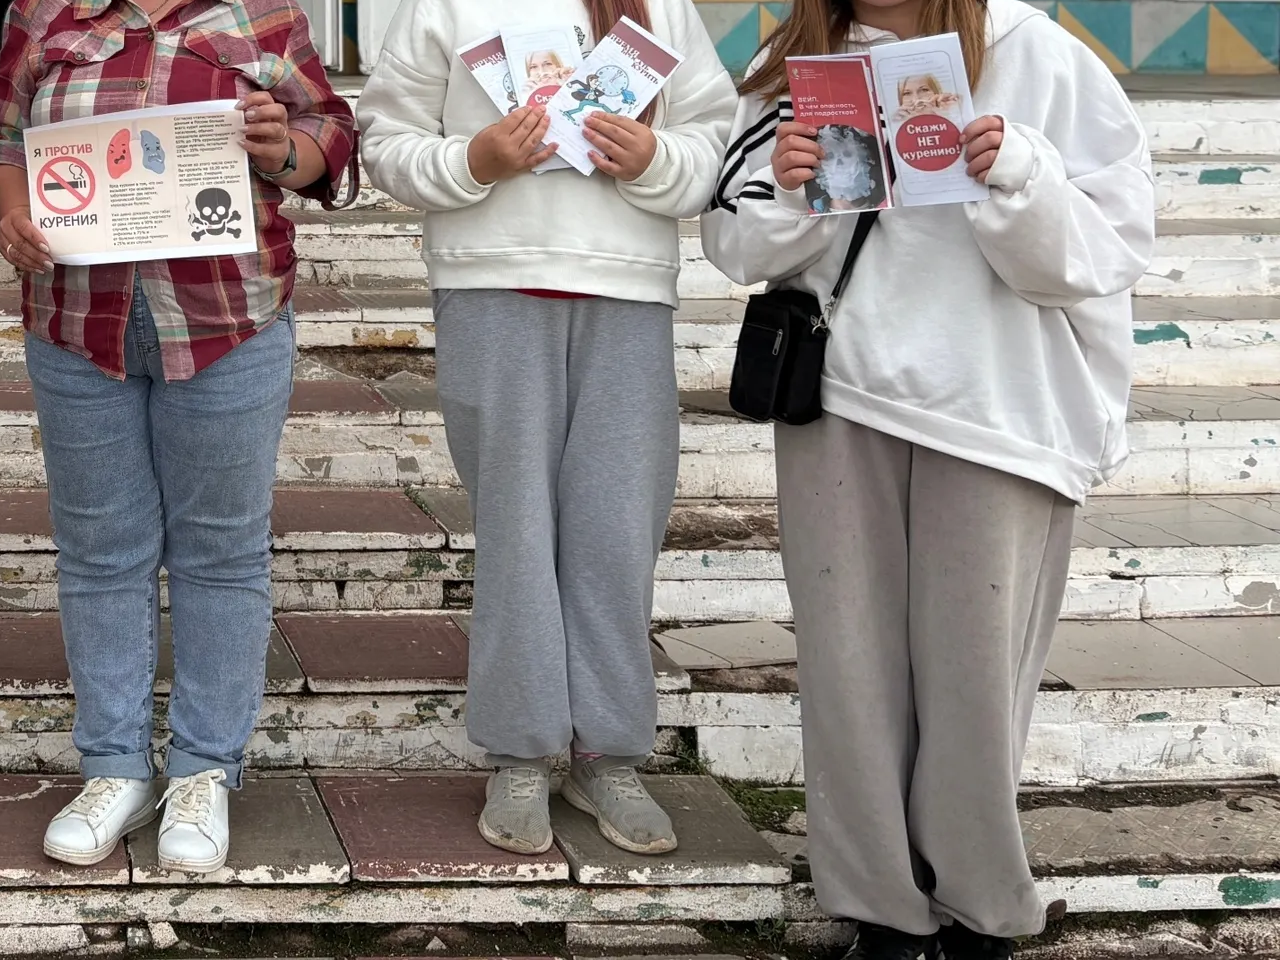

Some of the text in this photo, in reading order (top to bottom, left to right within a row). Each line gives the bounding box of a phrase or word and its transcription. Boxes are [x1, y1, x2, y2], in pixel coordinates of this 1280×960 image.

[906, 123, 948, 135] Скажи
[917, 135, 941, 147] НЕТ
[34, 143, 93, 158] Я ПРОТИВ
[902, 144, 960, 161] курению!
[39, 214, 98, 229] КУРЕНИЯ
